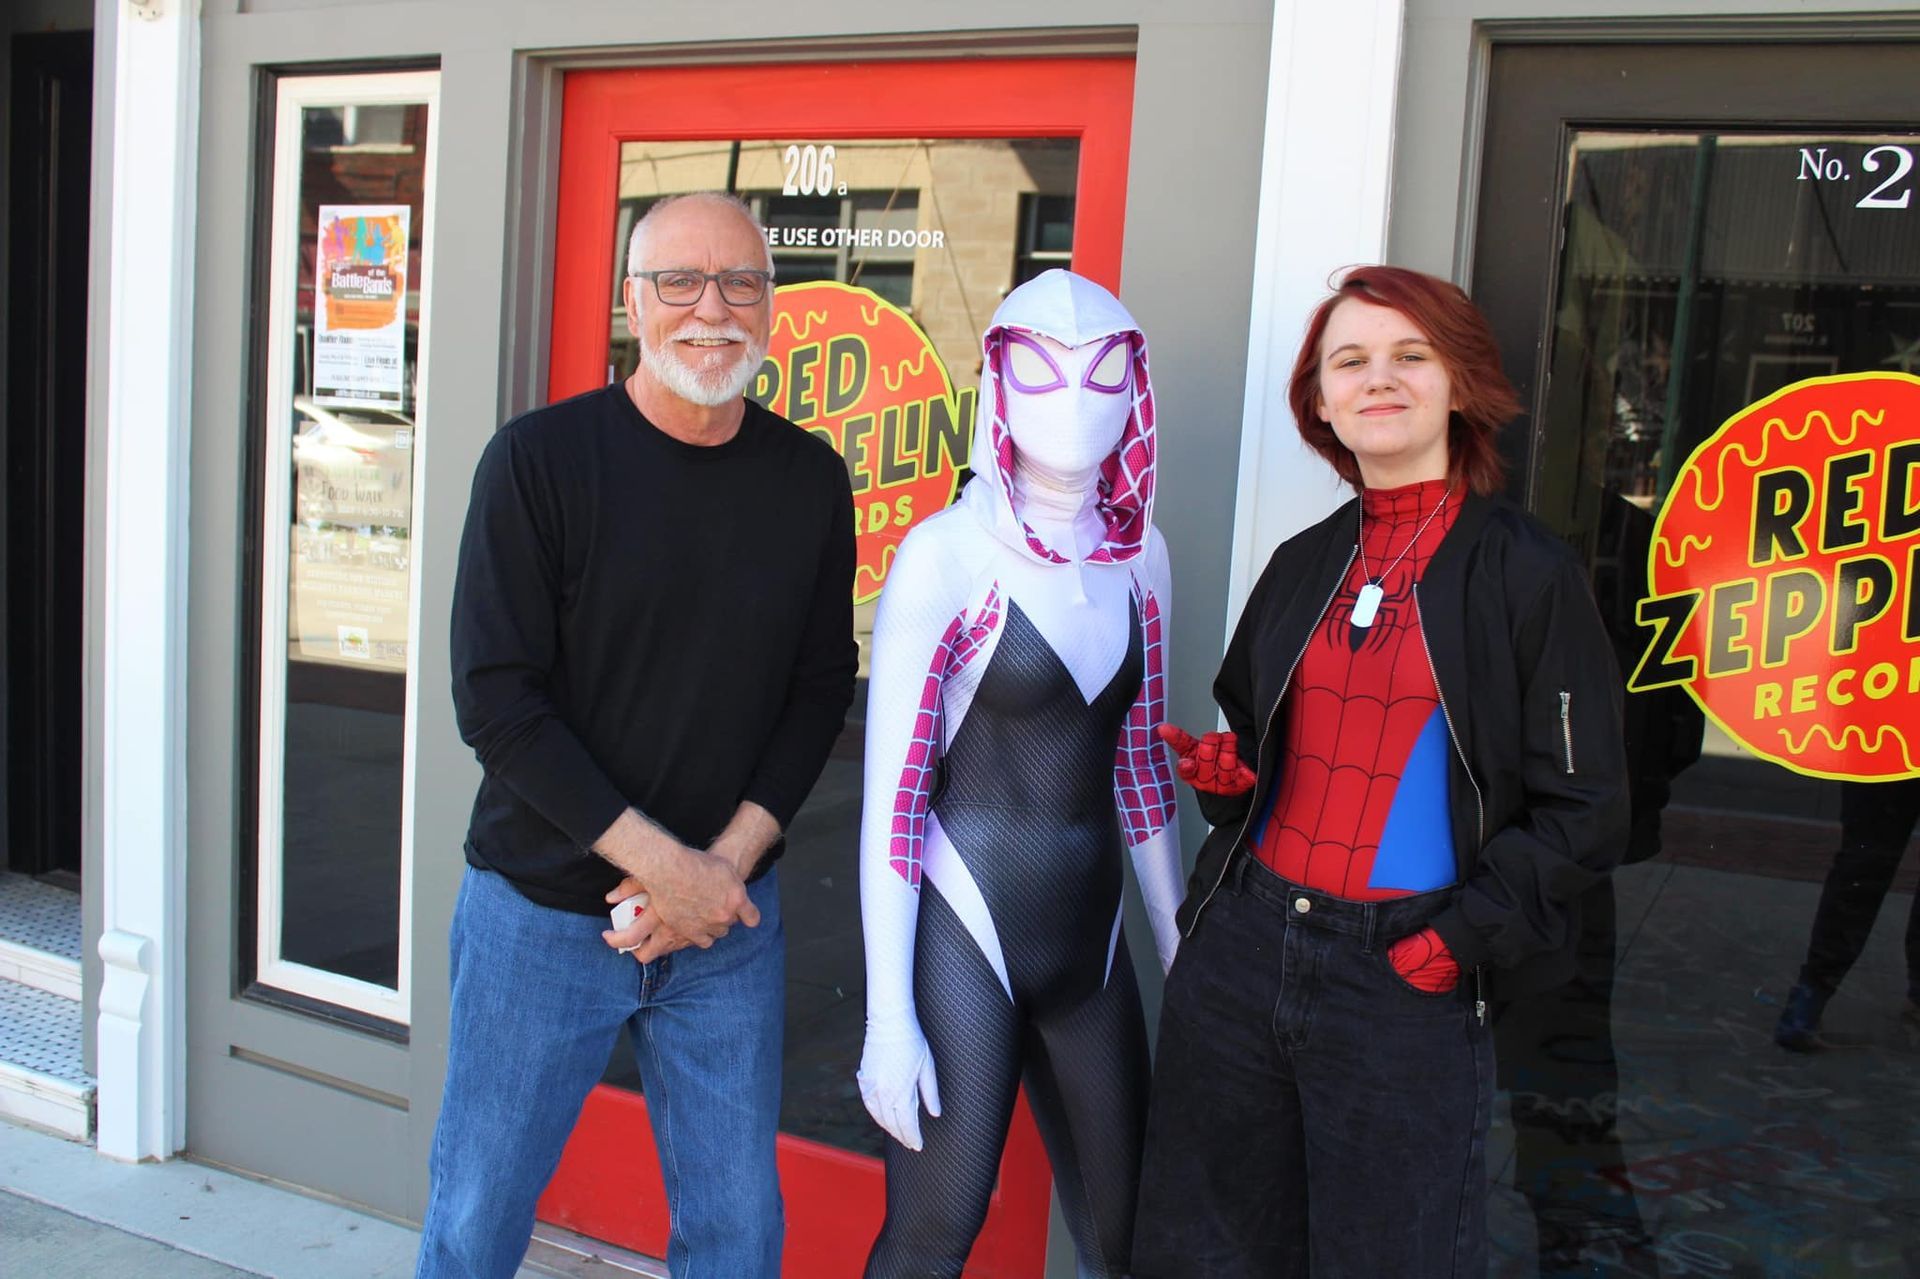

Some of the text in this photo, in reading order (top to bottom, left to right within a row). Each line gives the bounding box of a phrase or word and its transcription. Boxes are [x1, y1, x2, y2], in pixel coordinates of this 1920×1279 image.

[782, 144, 848, 197] 206 a
[1796, 145, 1914, 208] No. 2
[783, 227, 817, 246] USE
[821, 228, 883, 247] OTHER
[887, 229, 945, 248] DOOR
[331, 272, 393, 295] Battle Bands
[806, 387, 977, 495] ELIN
[1626, 545, 1920, 693] ZEPP
